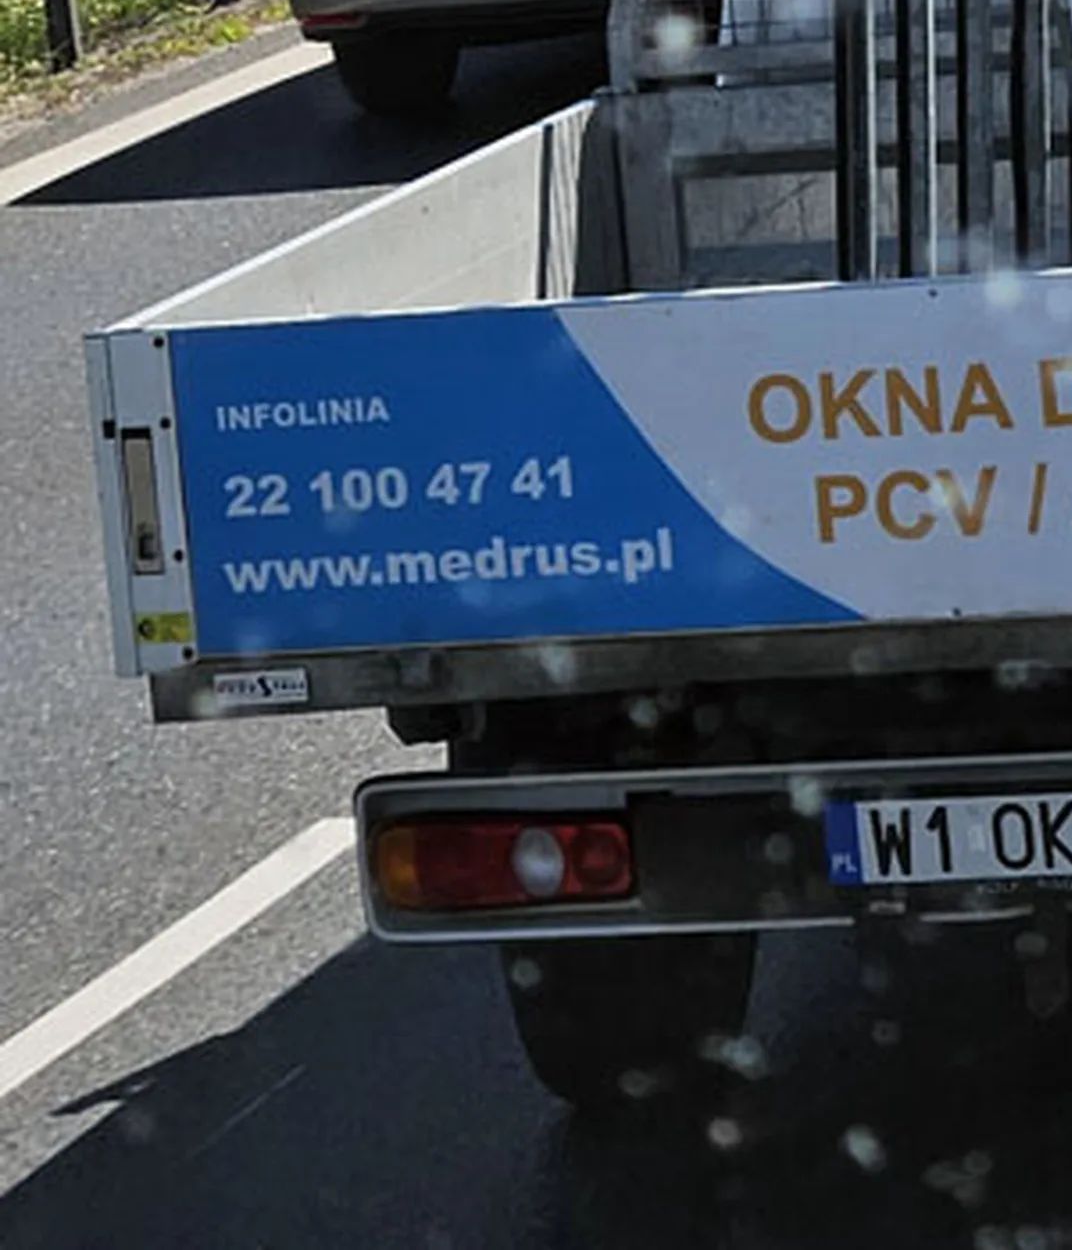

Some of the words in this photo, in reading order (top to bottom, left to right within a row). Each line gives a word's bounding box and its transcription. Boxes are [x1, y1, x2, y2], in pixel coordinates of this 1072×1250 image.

[215, 396, 390, 432] INFOLINIA
[747, 362, 1016, 444] OKNA
[223, 474, 291, 518] 22
[309, 466, 408, 513] 100
[425, 462, 491, 505] 47
[511, 455, 573, 500] 41
[814, 465, 998, 543] PCV
[1027, 462, 1048, 535] /
[223, 526, 673, 593] www.medrus.pl
[869, 806, 953, 877] W1
